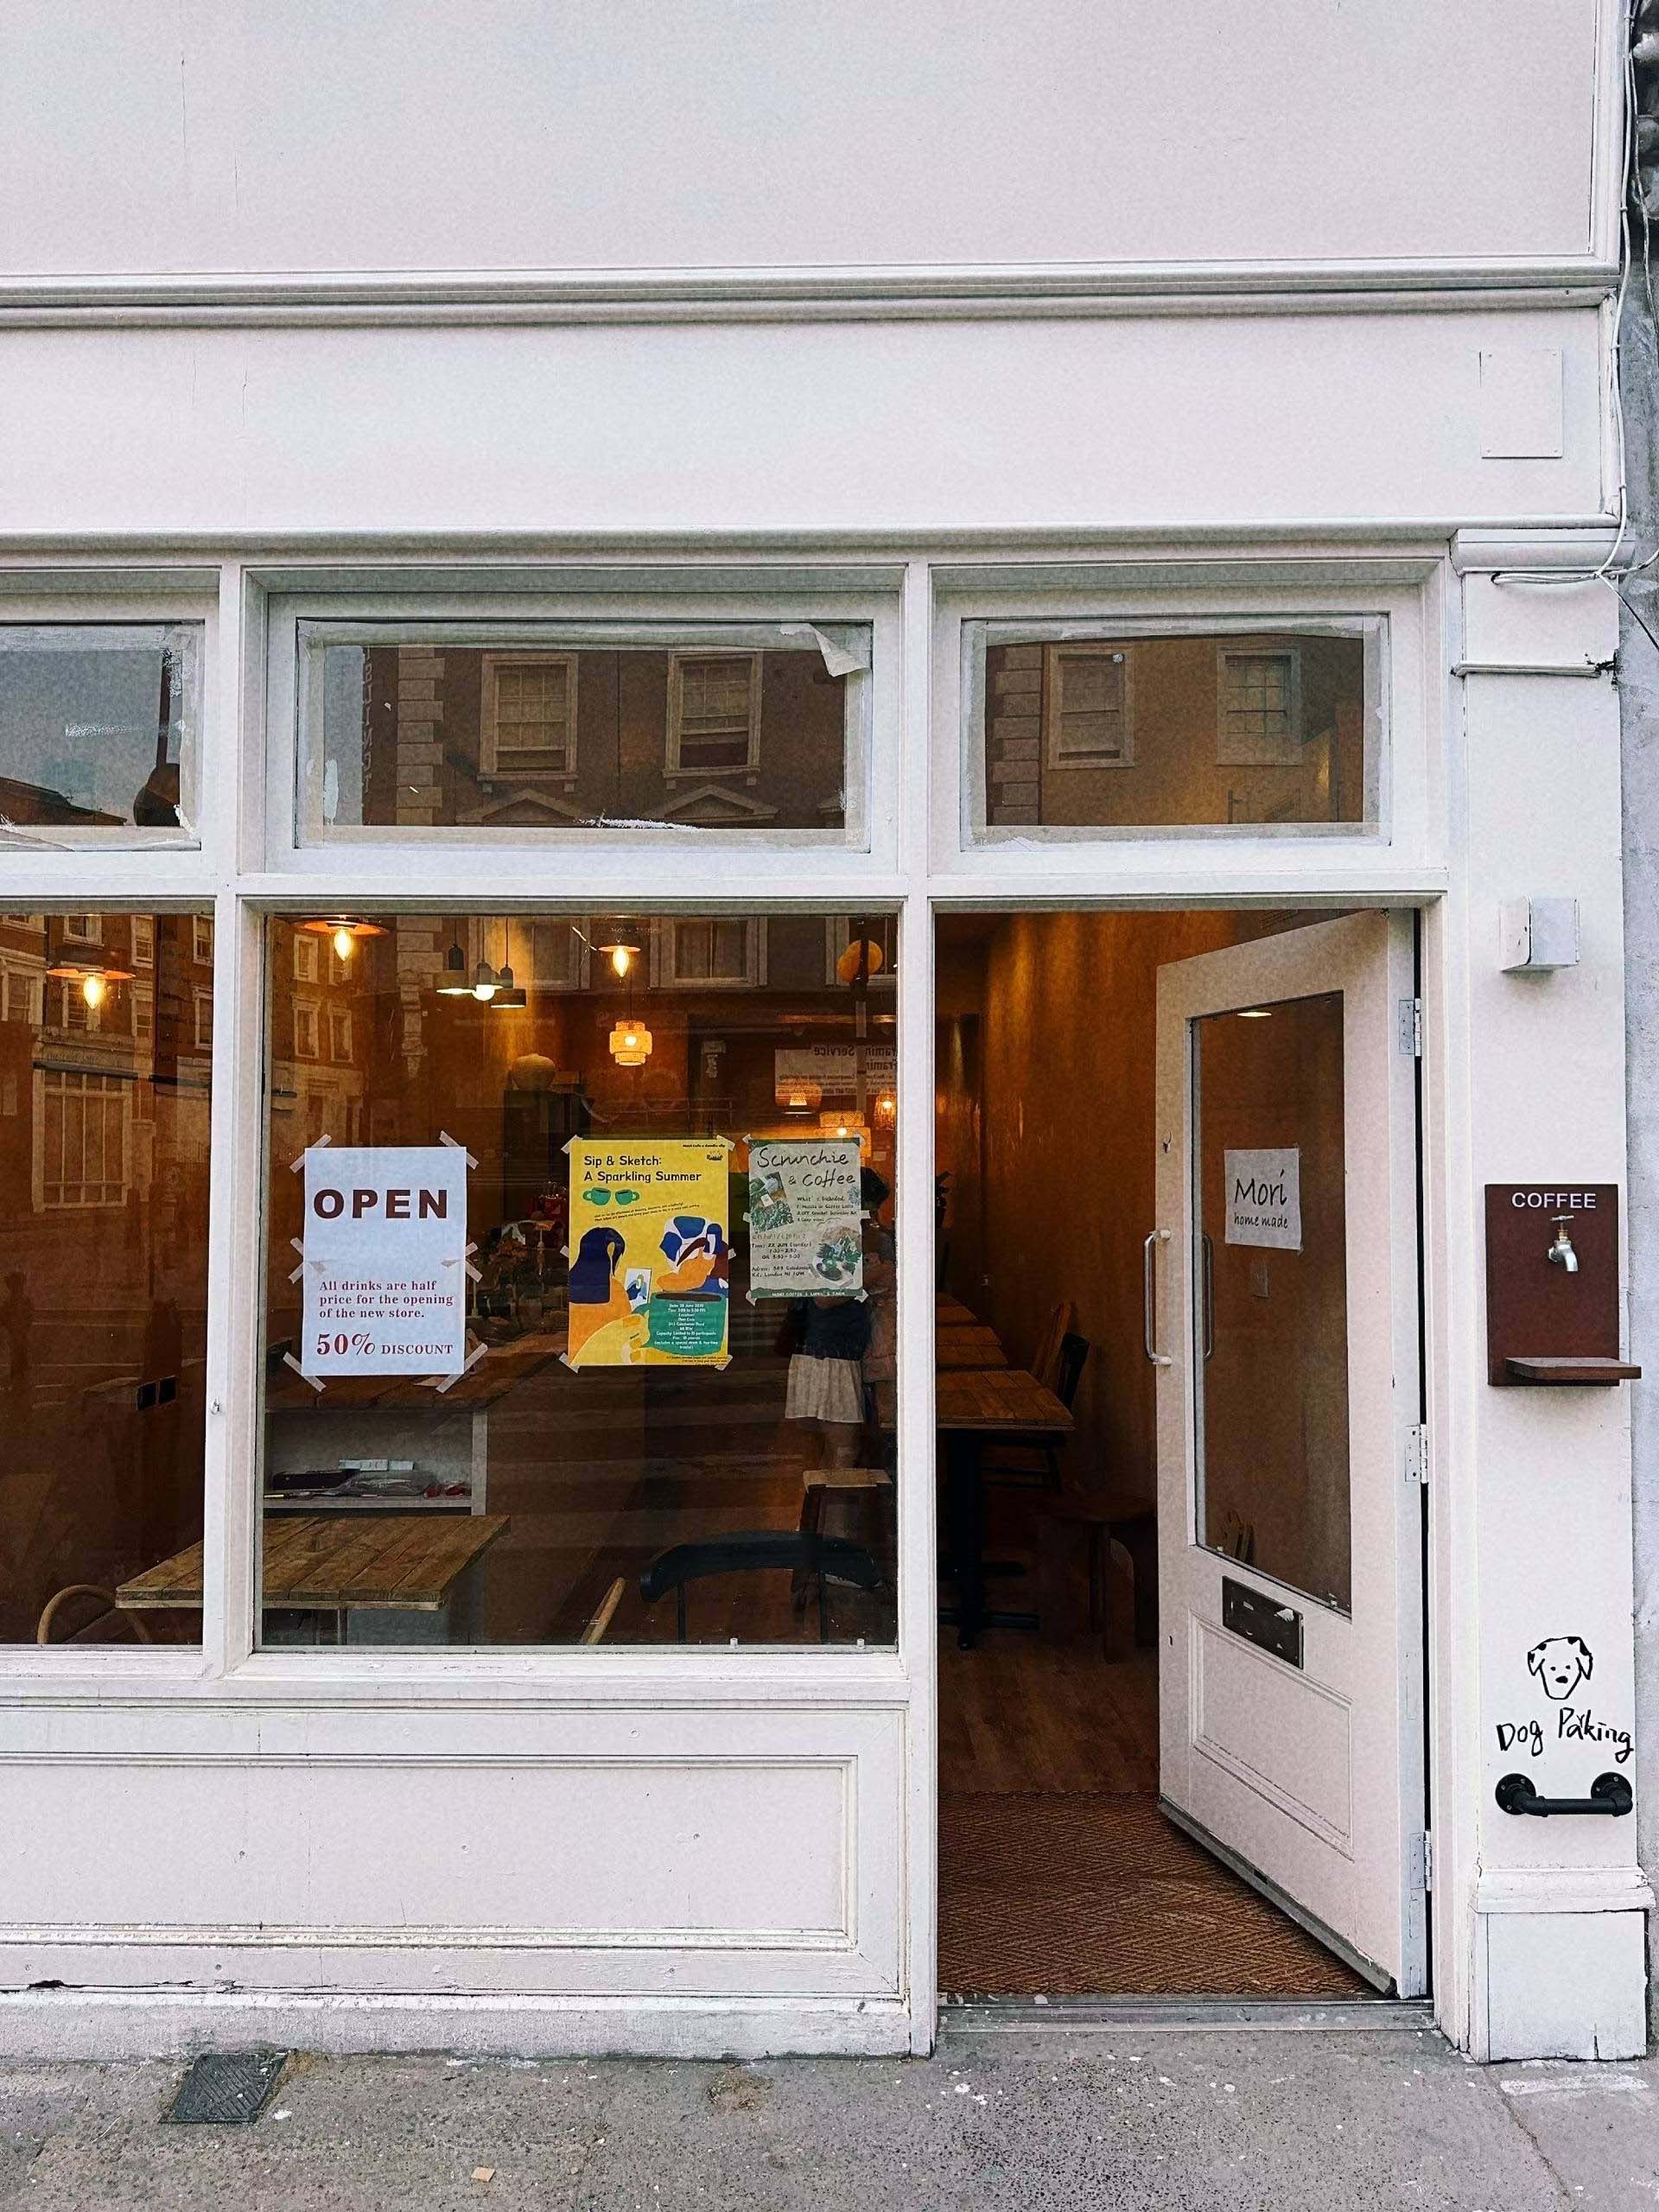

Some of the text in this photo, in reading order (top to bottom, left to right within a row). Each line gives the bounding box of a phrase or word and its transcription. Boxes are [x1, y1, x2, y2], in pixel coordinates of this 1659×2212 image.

[584, 1155, 662, 1168] Sip & Sketch:
[757, 1147, 849, 1168] Scrunchie
[583, 1171, 702, 1184] A Sparkling Summer
[788, 1175, 797, 1185] &
[1234, 1168, 1288, 1206] Mori
[313, 1189, 448, 1219] OPEN
[1511, 1192, 1597, 1209] COFFEE
[1234, 1212, 1288, 1229] home made
[320, 1281, 437, 1291] All drinks are half
[320, 1294, 453, 1306] price for the opening
[320, 1308, 425, 1319] of the new store.
[316, 1332, 453, 1356] 50% DISCOUNT
[1496, 1719, 1543, 1758] Dog
